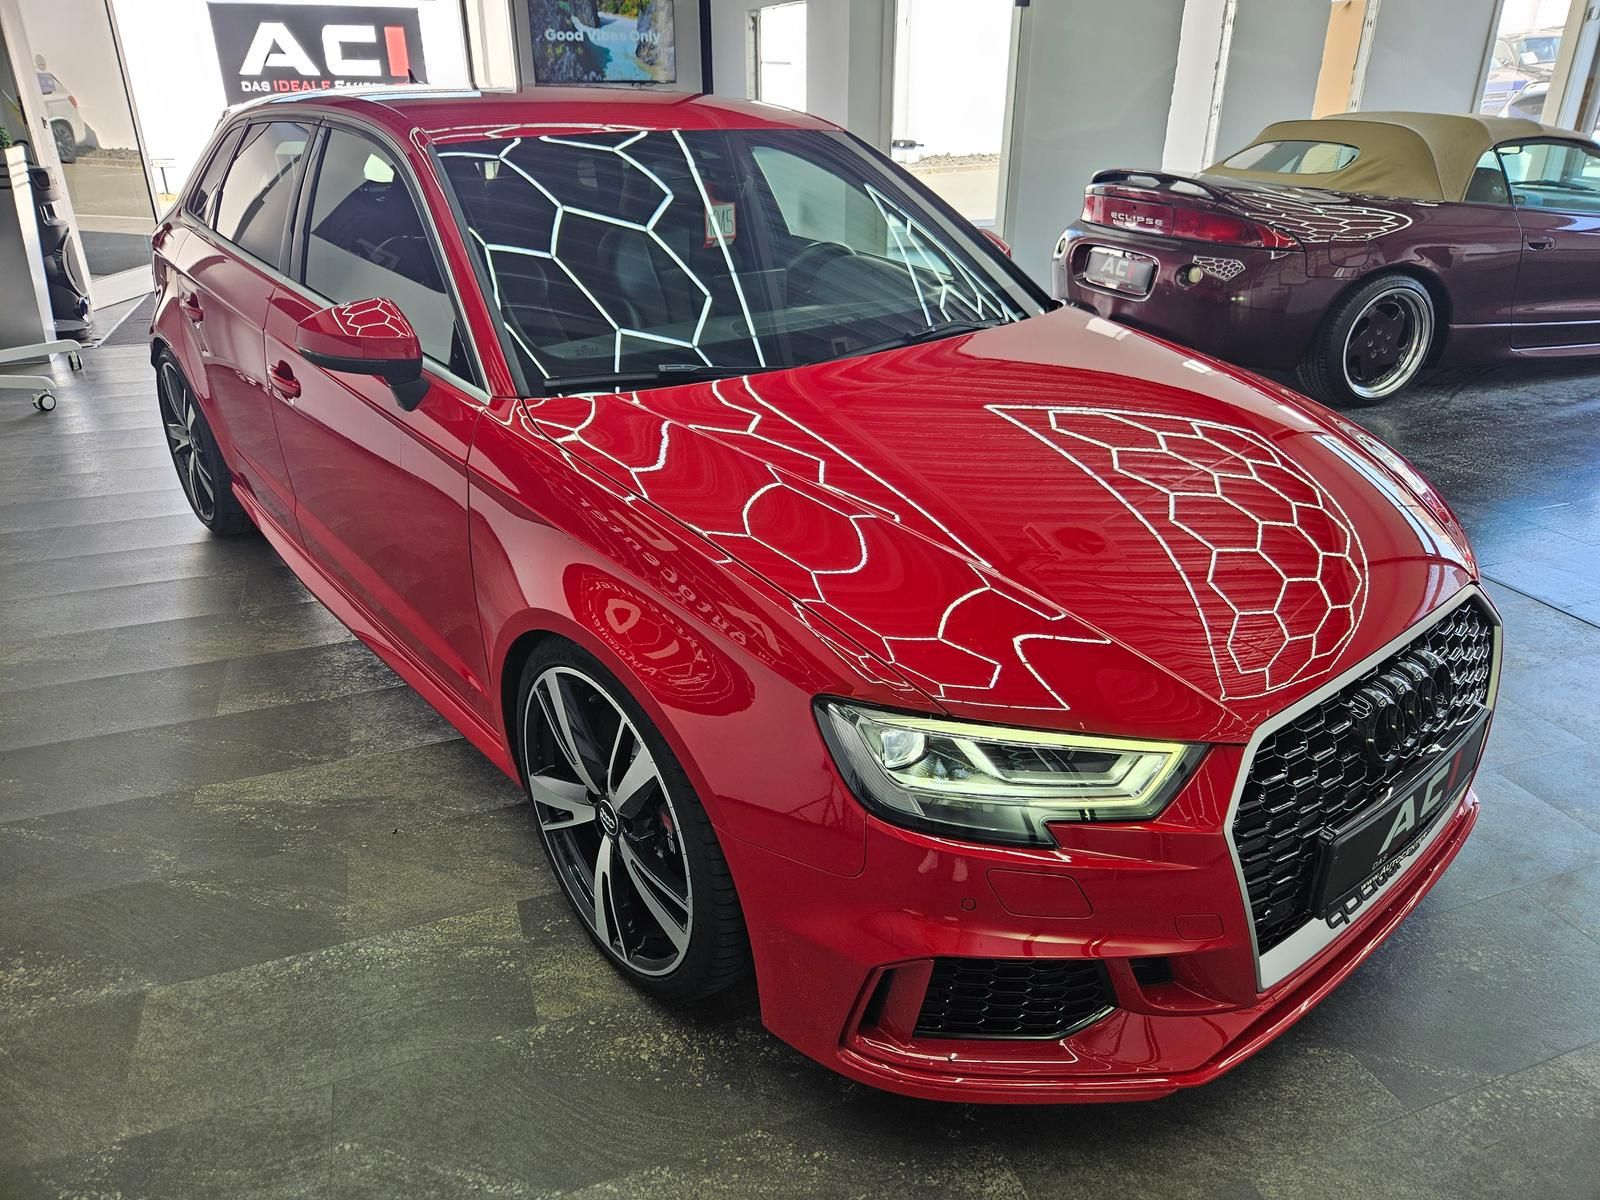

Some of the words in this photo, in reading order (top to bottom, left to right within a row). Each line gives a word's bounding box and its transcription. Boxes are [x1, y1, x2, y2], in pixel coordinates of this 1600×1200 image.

[544, 28, 584, 42] Good
[588, 28, 627, 42] Vibes
[630, 29, 661, 46] Only
[241, 80, 271, 92] DAS
[1110, 211, 1163, 225] ECLIPSE
